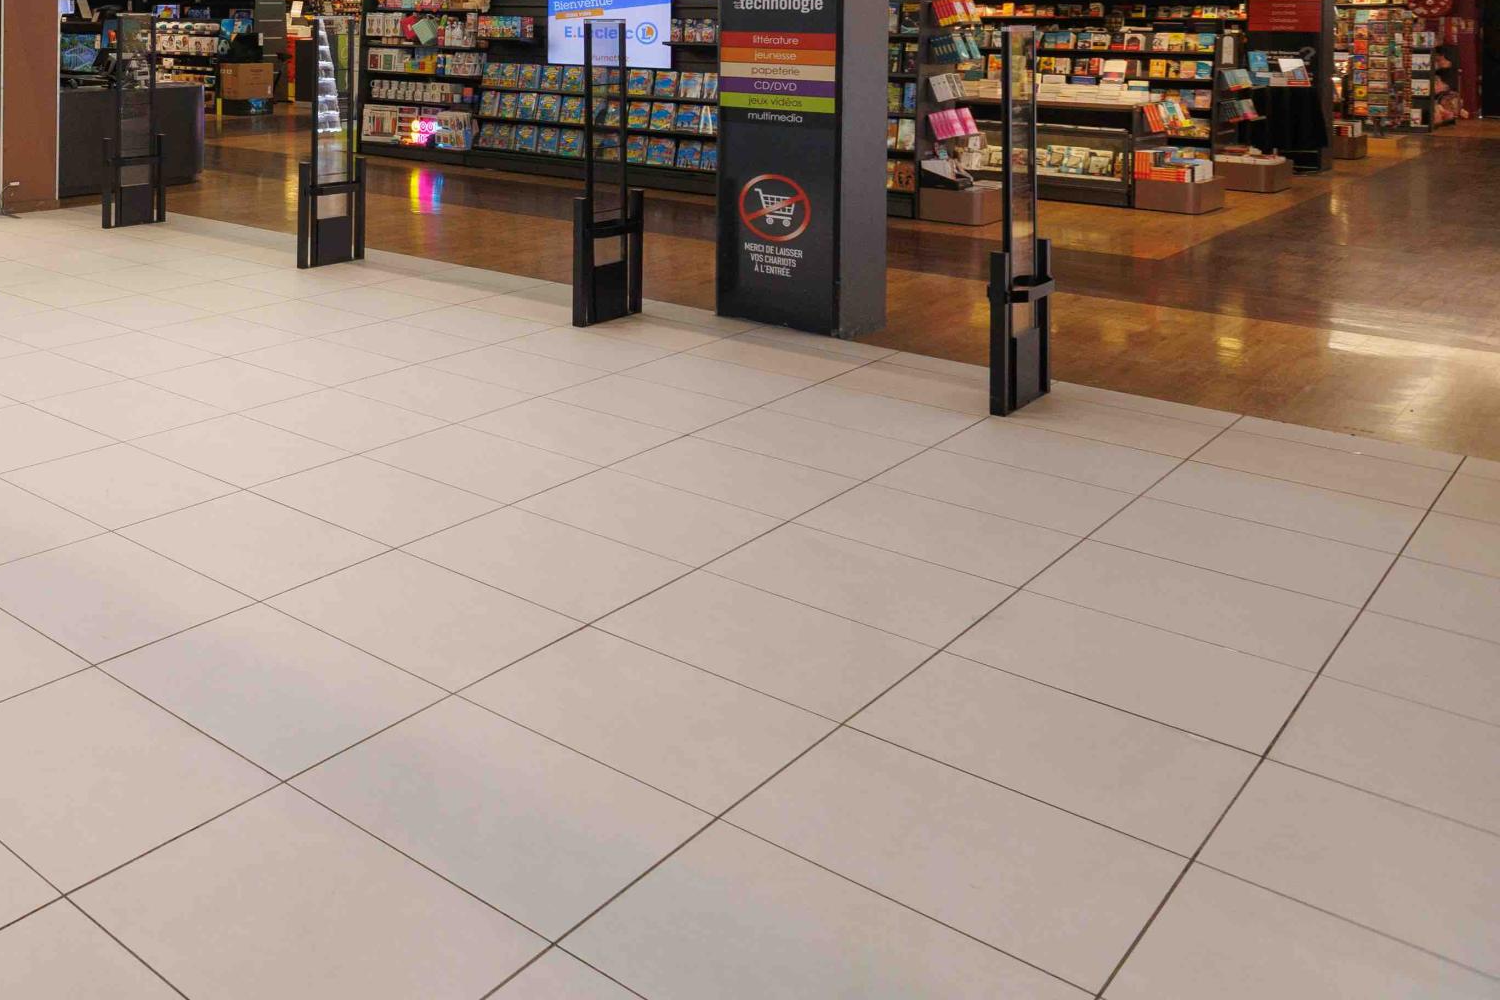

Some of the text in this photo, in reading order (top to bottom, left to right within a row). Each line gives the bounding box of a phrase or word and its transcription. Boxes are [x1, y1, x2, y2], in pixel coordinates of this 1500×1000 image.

[564, 24, 634, 40] E.Lclec
[752, 34, 799, 45] littérature
[754, 48, 797, 61] jeunesse
[751, 65, 801, 77] papeterie
[753, 80, 797, 92] CD/DVD
[748, 96, 769, 106] jeux
[747, 111, 803, 123] multimedia
[744, 242, 803, 259] MERCI DE LAISSER
[750, 252, 797, 268] VOS CHARIOTS
